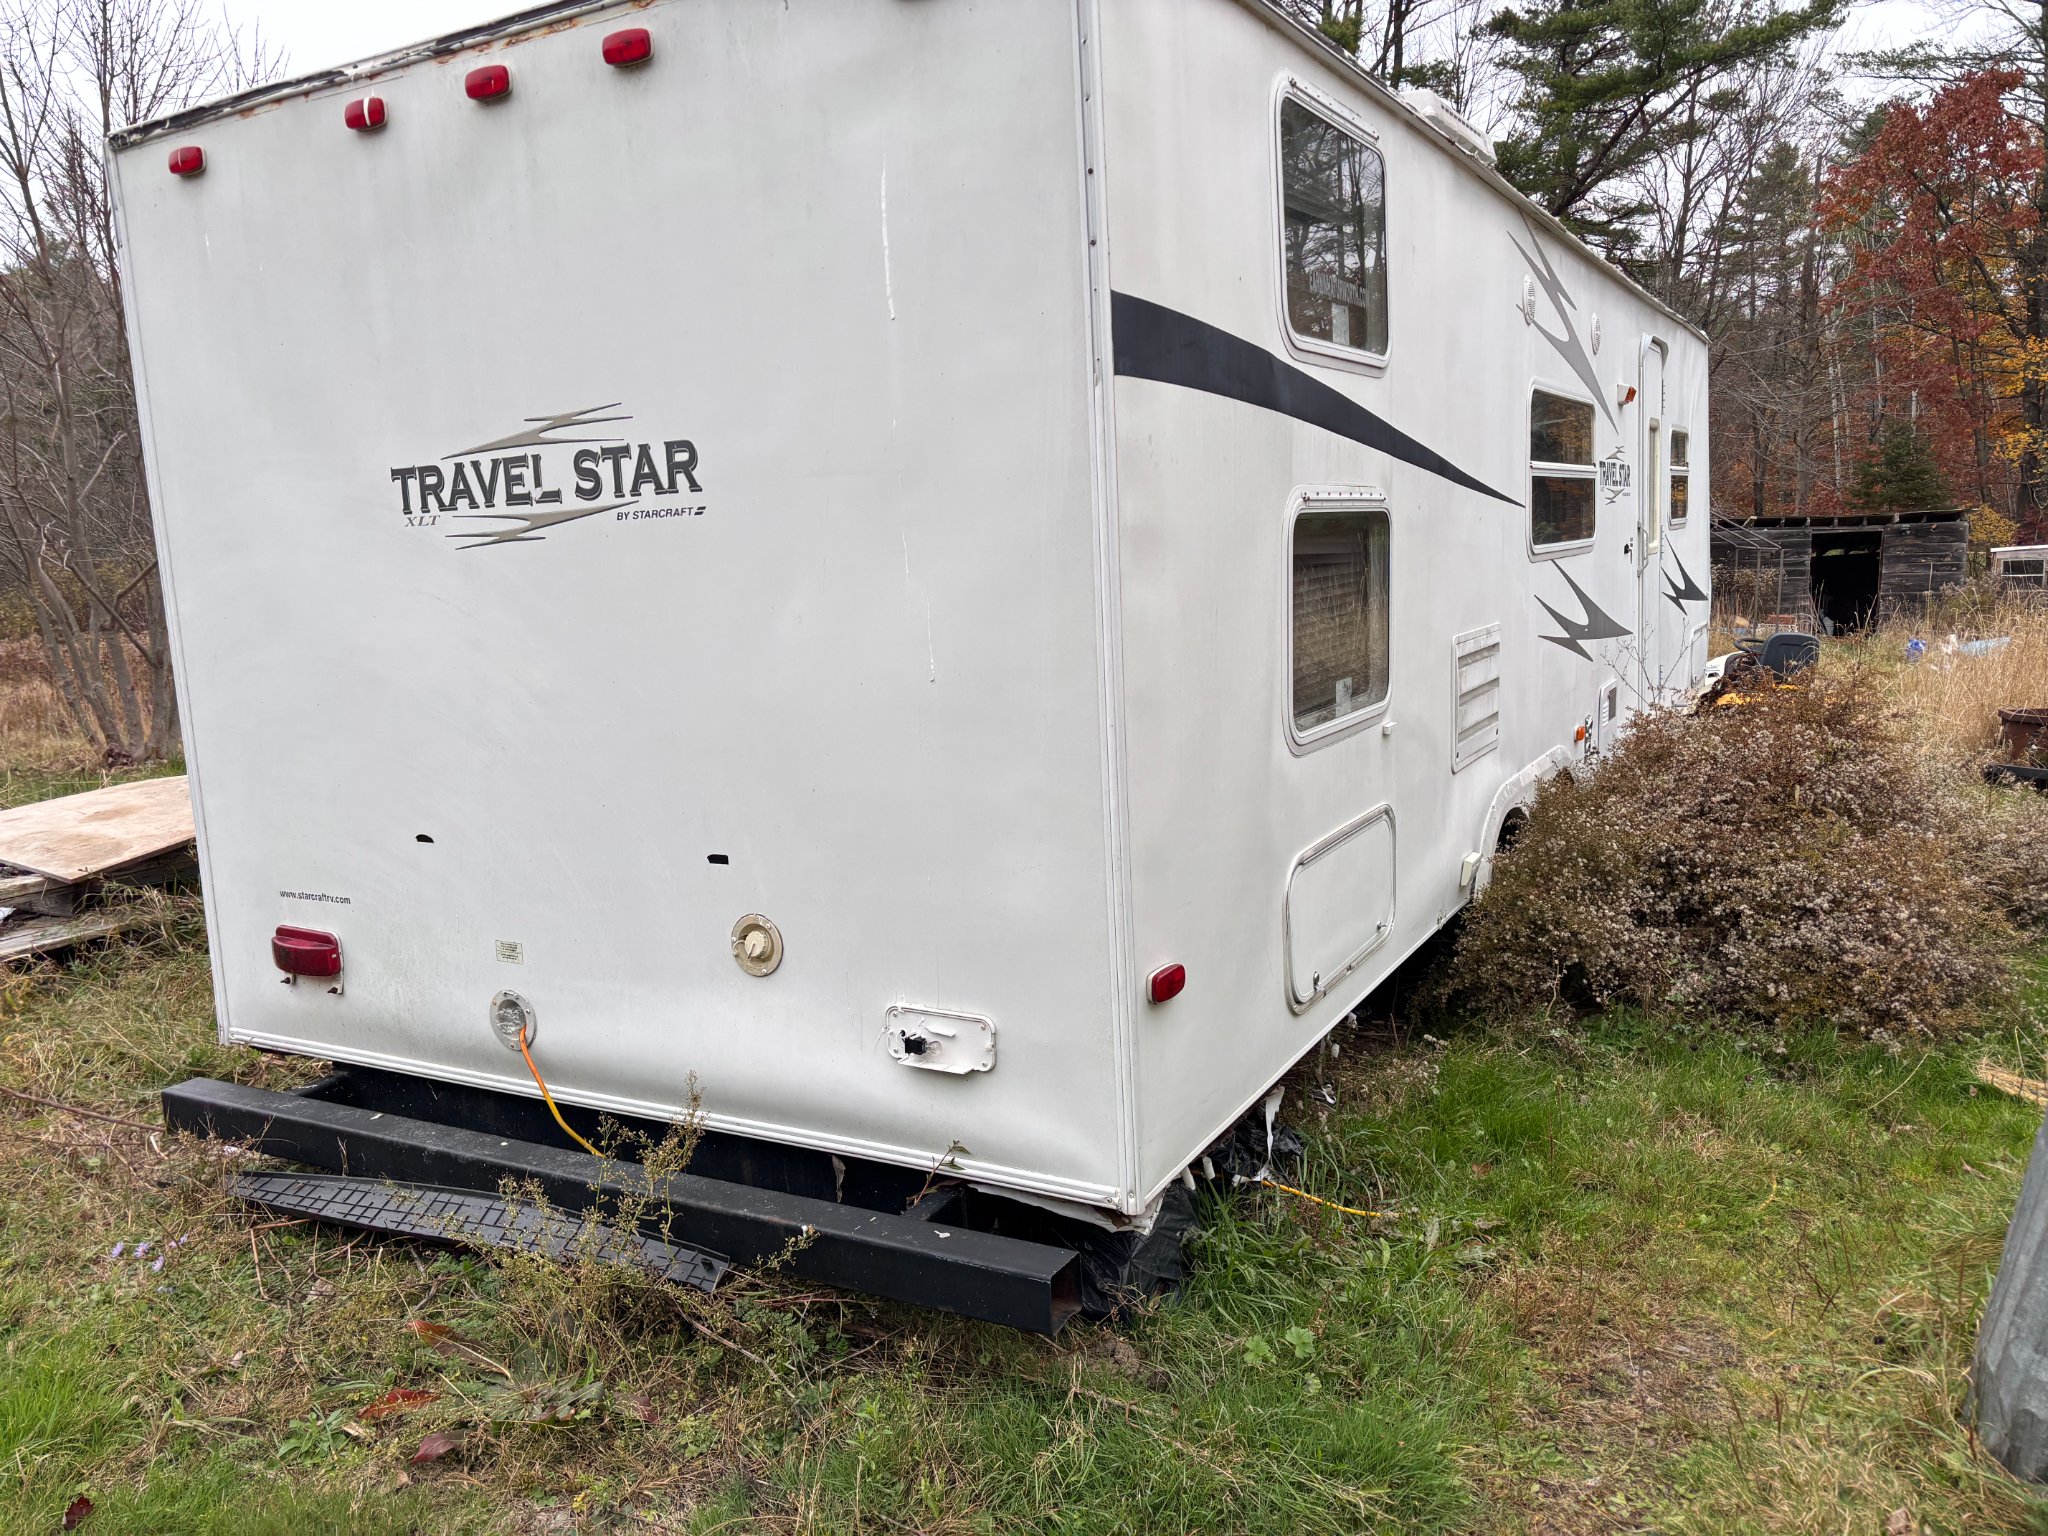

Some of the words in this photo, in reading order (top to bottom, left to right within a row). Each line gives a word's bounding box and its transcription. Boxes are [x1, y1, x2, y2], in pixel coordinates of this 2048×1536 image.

[390, 453, 563, 515] TRAVEL
[573, 439, 703, 501] STAR
[404, 514, 441, 527] XLT
[616, 511, 630, 521] BY
[632, 506, 694, 520] STARCRAFT
[279, 890, 351, 904] www.starcraftrv.com
